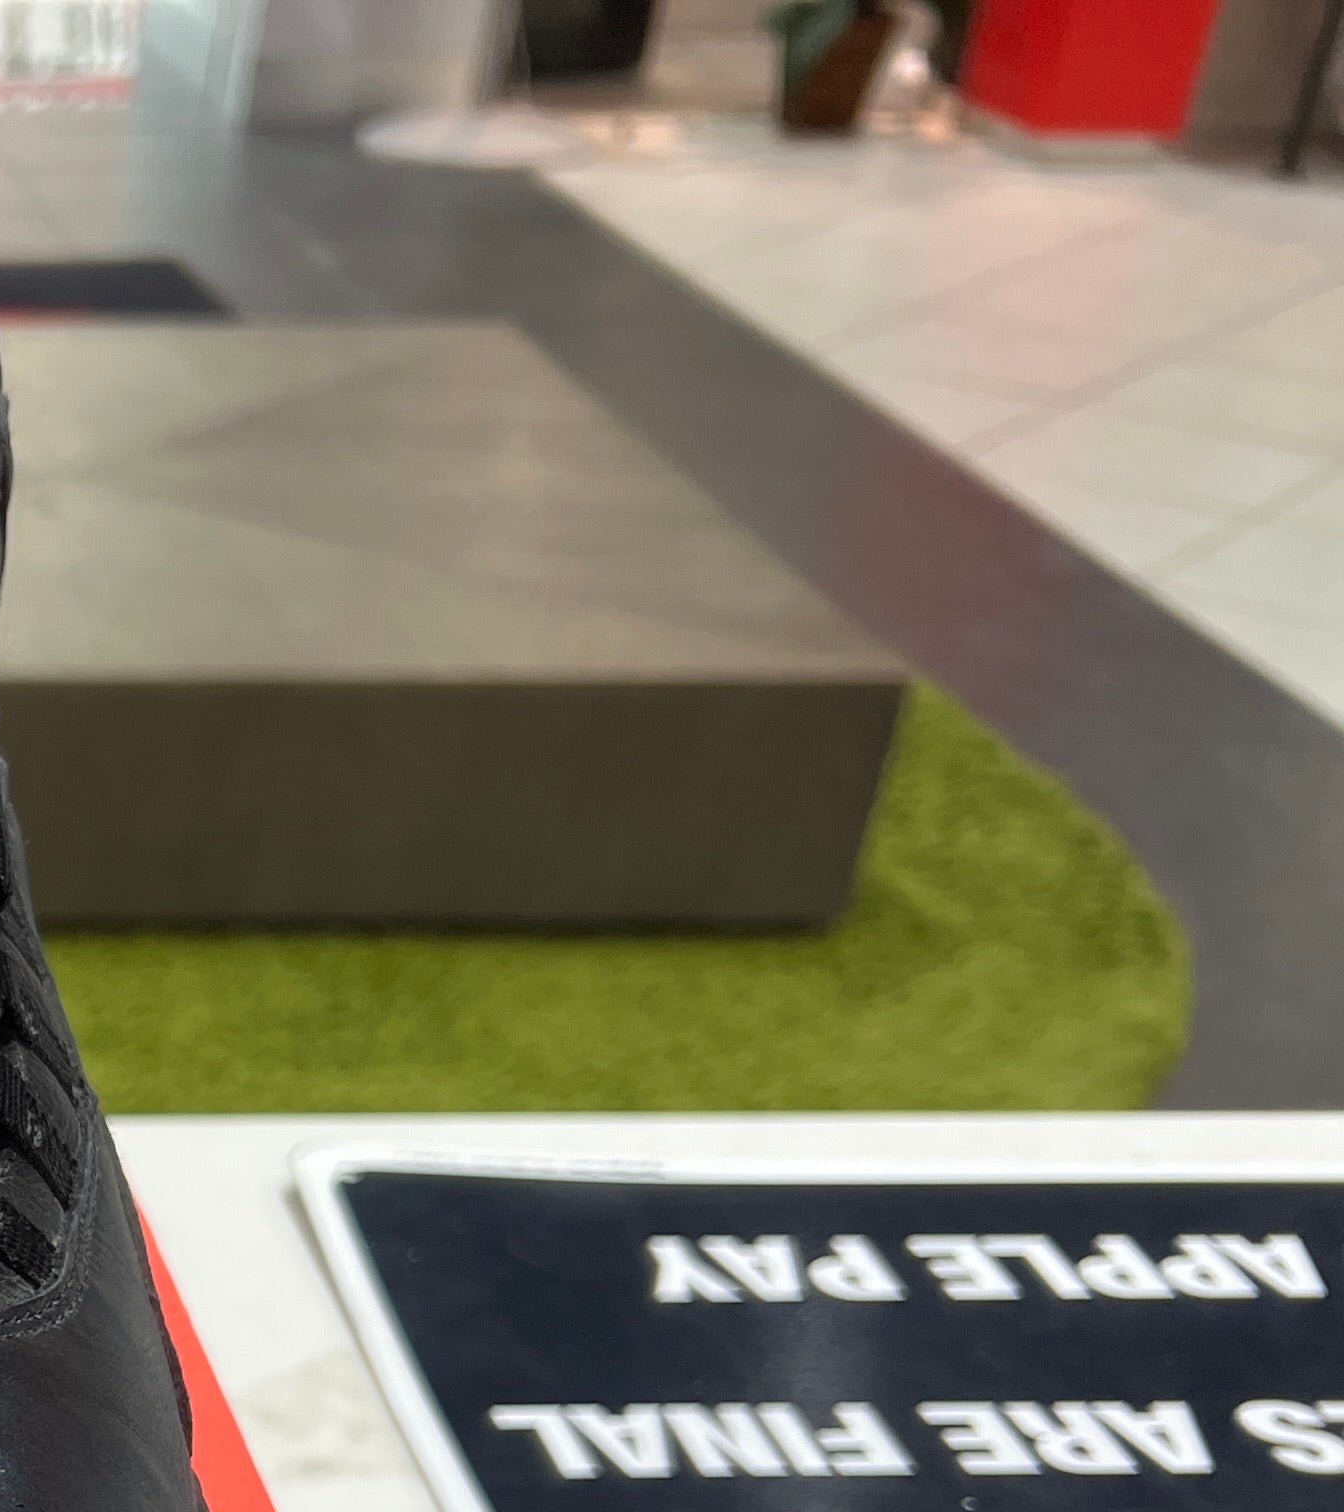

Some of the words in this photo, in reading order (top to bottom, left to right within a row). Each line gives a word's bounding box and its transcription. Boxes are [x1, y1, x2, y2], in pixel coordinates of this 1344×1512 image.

[643, 1233, 907, 1303] PAY
[905, 1233, 1329, 1300] APPLE
[489, 1402, 917, 1479] FINAL
[917, 1400, 1216, 1476] ARE
